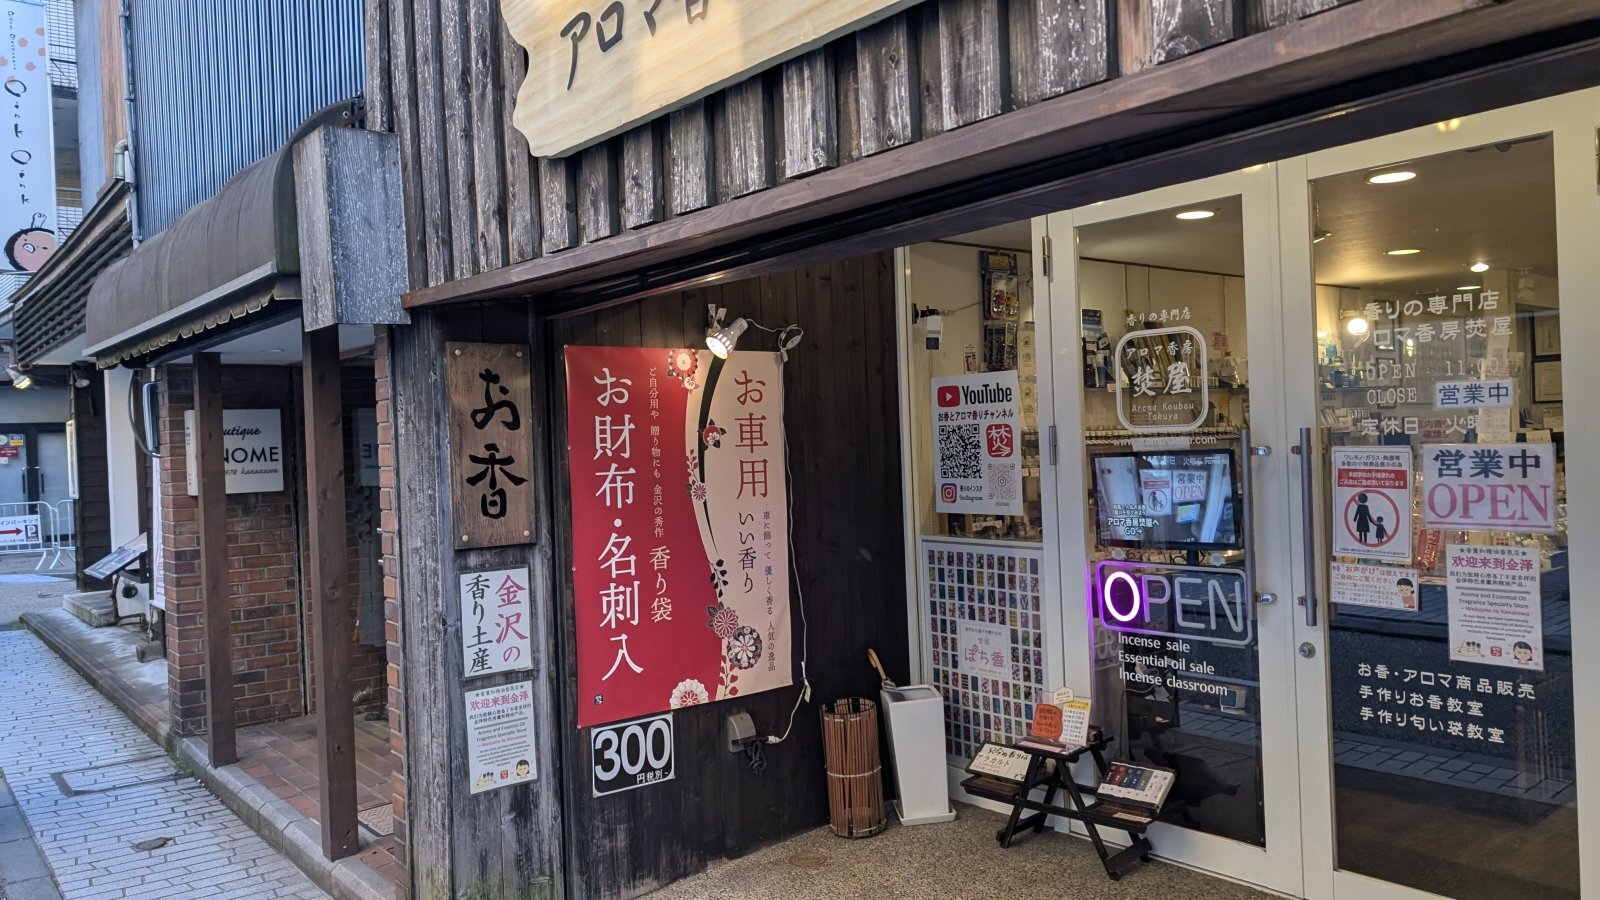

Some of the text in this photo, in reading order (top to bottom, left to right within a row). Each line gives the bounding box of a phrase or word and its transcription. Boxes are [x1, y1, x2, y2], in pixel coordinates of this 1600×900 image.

[1126, 307, 1191, 327] 香りの専門店
[1363, 290, 1500, 320] 香りの専門店
[1126, 340, 1194, 360] アロマ香房
[1131, 361, 1192, 398] 焚屋
[1366, 362, 1416, 381] OPEN
[962, 382, 1012, 405] YouTube
[1132, 402, 1194, 412] Aroma Koubou
[1367, 388, 1416, 404] CLOSE
[1439, 383, 1509, 406] 営業中
[938, 408, 1014, 422] お香とアロマ香りチャンネル
[1361, 416, 1418, 436] 定休日
[466, 369, 529, 520] お香
[734, 370, 768, 500] お車用
[650, 367, 664, 538] ご自分用や 贈り物にも 金沢の秀作
[1433, 449, 1541, 478] 営業中
[1174, 486, 1205, 500] OPEN
[1176, 473, 1204, 484] 営業中
[1428, 483, 1551, 521] OPEN
[593, 367, 644, 681] お財布・名刺入
[738, 512, 757, 594] いい香り
[1452, 556, 1534, 572] 欢迎来到金泽
[650, 545, 672, 622] 香り袋
[763, 511, 776, 672] 車に飾って 優しく香る 人気の逸品
[1104, 572, 1244, 632] OPEN
[466, 574, 494, 674] 香り土産
[495, 574, 528, 662] 金沢の
[1118, 632, 1190, 652] Incense sale
[1118, 650, 1214, 674] Essential oil sale
[1119, 668, 1228, 696] Incense classroom
[1358, 662, 1536, 700] お香・アロマ商品販売
[1359, 685, 1484, 717] 手作りお香教室
[1360, 707, 1504, 744] 手作り匂い袋教室
[595, 720, 670, 780] 300
